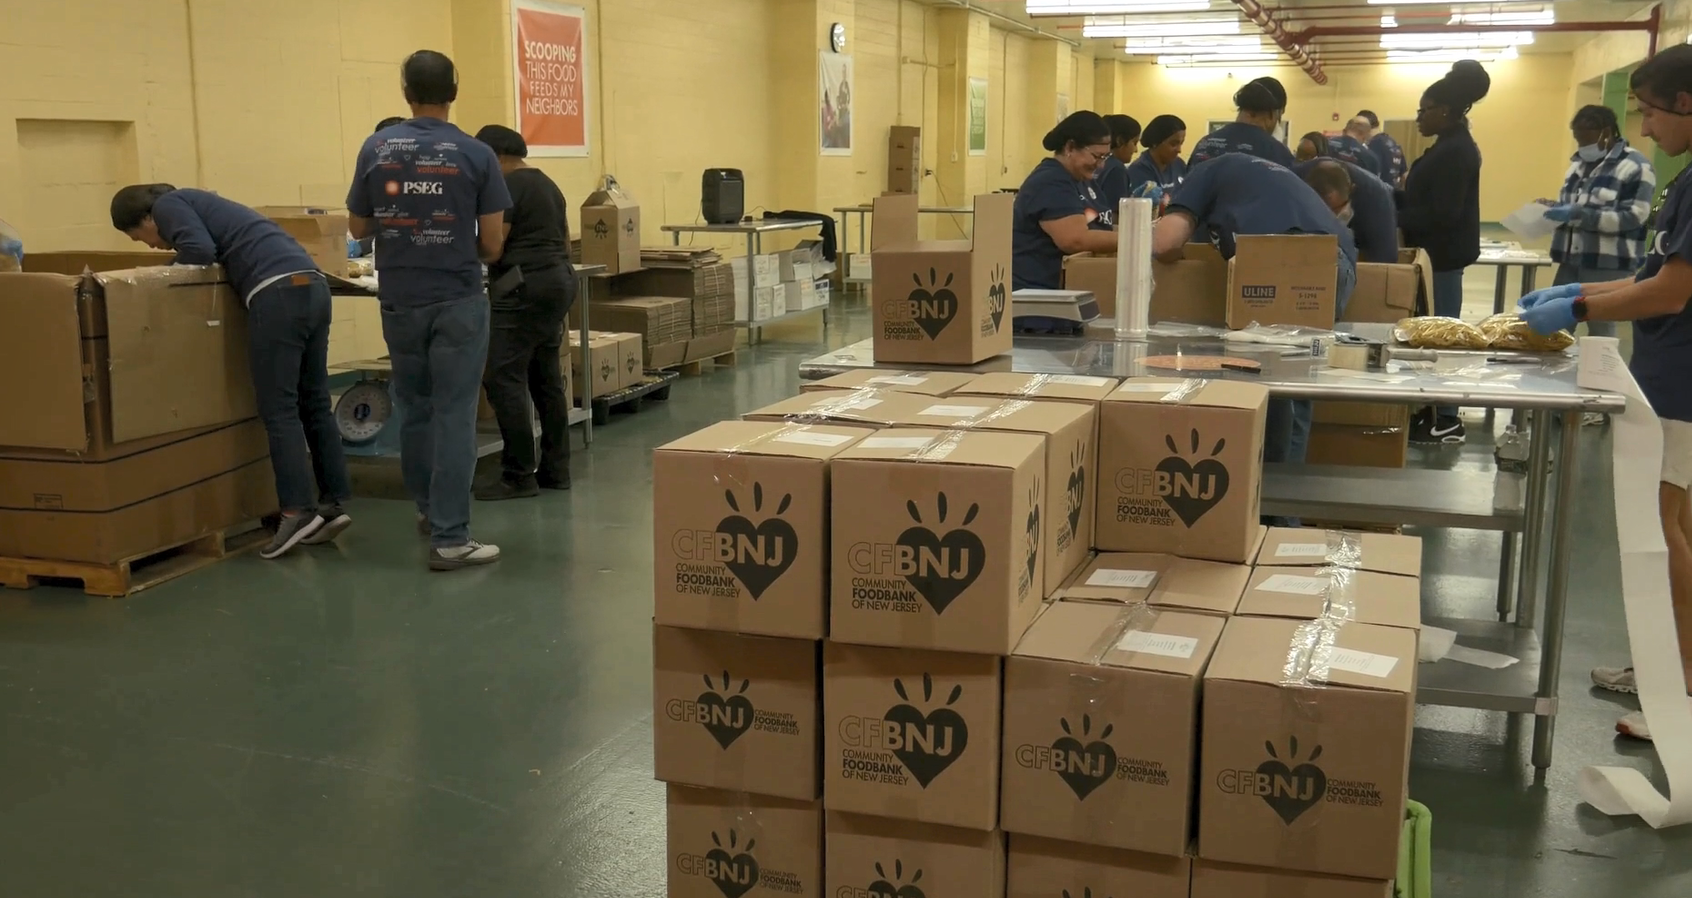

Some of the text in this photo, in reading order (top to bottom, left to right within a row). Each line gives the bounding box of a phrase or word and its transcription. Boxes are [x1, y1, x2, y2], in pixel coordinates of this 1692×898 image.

[525, 41, 577, 63] SCOOPING
[526, 61, 577, 82] THIS FOOD
[530, 81, 574, 98] FEEDS MY
[526, 97, 578, 116] NEIGHBORS
[375, 141, 420, 154] volunteer
[417, 165, 459, 175] volunteer
[403, 181, 443, 195] PSEG
[410, 232, 454, 244] volunteer
[1243, 286, 1276, 297] ULINE
[881, 298, 949, 319] CFBNJ
[884, 327, 921, 335] FOODBANK
[1114, 466, 1217, 500] CFBNJ
[1117, 496, 1163, 507] COMMUNITY
[1117, 505, 1171, 518] FOODBANK
[1116, 514, 1176, 527] OF NEW JERSEY
[671, 528, 783, 567] CFBNJ
[847, 541, 969, 580] CFBNJ
[676, 562, 726, 575] COMMUNITY
[676, 573, 735, 587] FOODBANK
[851, 577, 907, 590] COMMUNITY
[676, 584, 741, 598] OF NEW JERSEY
[852, 588, 917, 603] FOODBANK
[851, 599, 923, 613] OF NEW JERSEY
[665, 698, 744, 729] CFBNJ
[754, 709, 794, 720] COMMUNITY
[754, 716, 798, 729] FOODBANK
[763, 725, 779, 734] NEW
[778, 728, 800, 736] JERSEY
[838, 715, 953, 756] CFBNJ
[842, 748, 893, 763] COMMUNITY
[1015, 743, 1106, 778] CFBNJ
[1117, 756, 1163, 769] COMMUNITY
[842, 759, 903, 776] FOODBANK
[1117, 764, 1168, 779] FOODBANK
[842, 769, 909, 786] OF NEW JERSEY
[1116, 772, 1170, 787] OF NEW JERSEY
[1216, 768, 1314, 801] CFBNJ
[1327, 778, 1376, 789] COMMUNITY
[1327, 786, 1381, 800] FOODBANK
[1326, 795, 1383, 808] OF NEW JERSEY
[676, 852, 750, 885] CFBNJ
